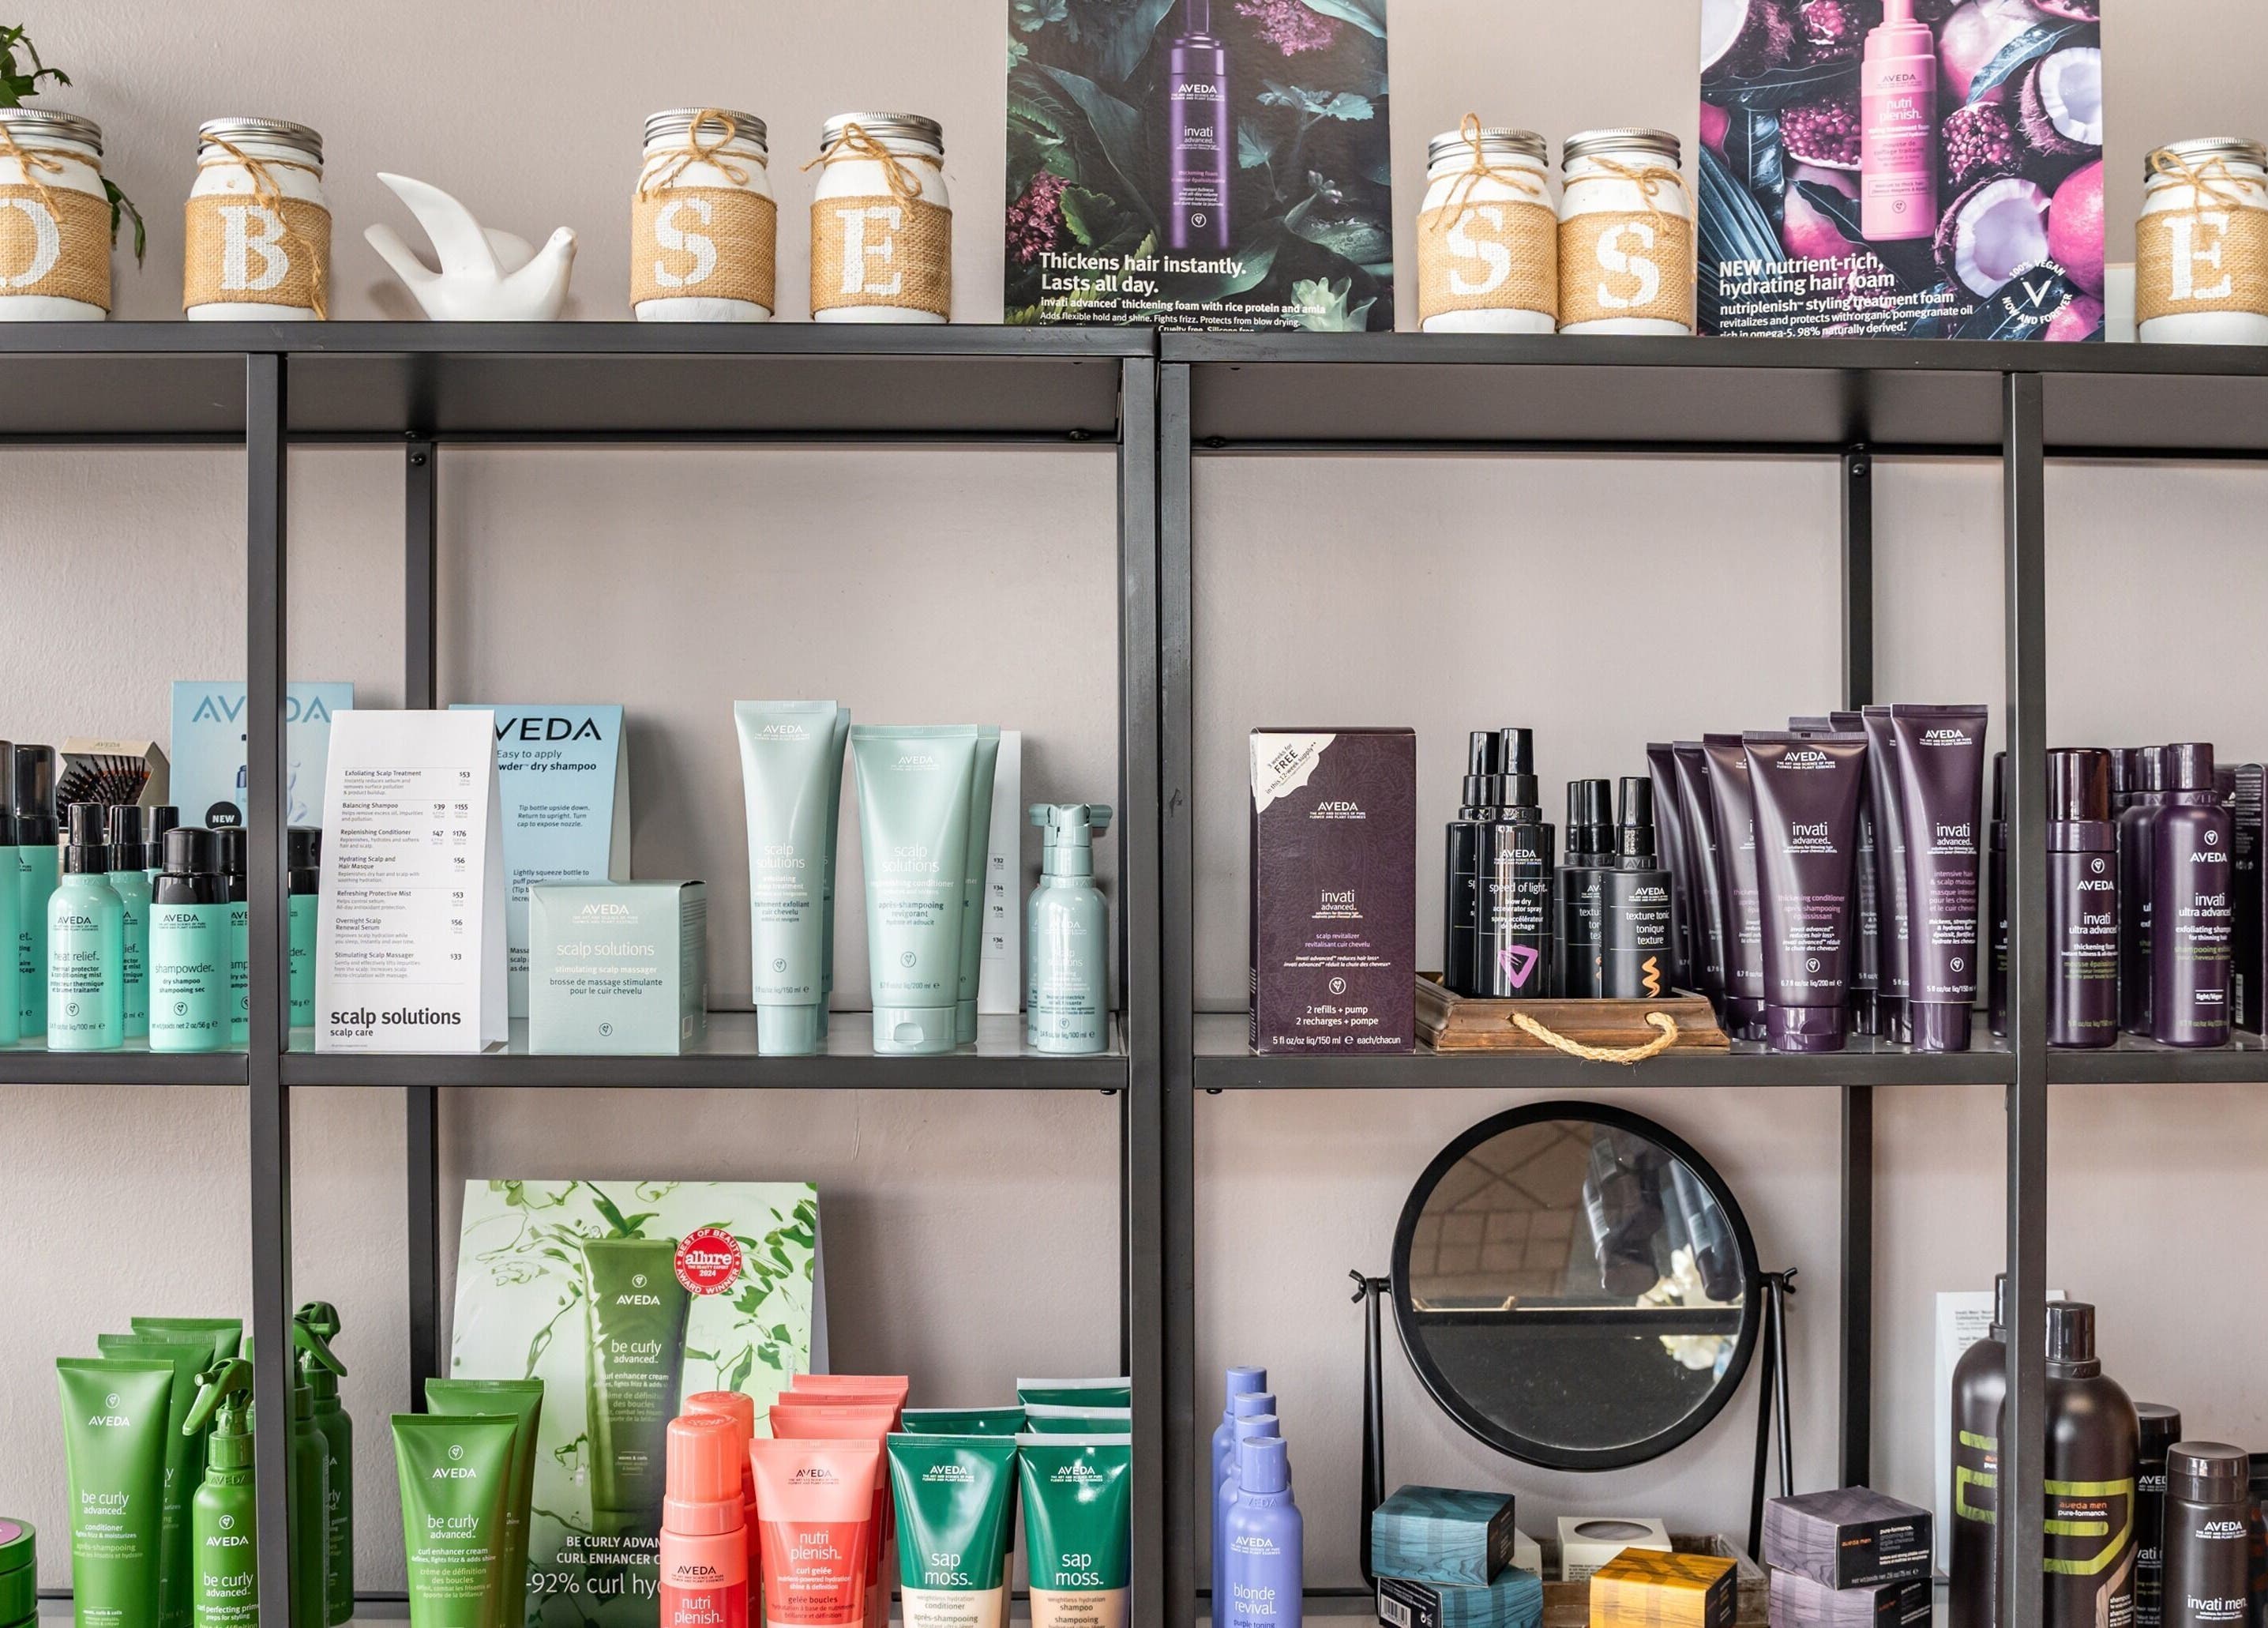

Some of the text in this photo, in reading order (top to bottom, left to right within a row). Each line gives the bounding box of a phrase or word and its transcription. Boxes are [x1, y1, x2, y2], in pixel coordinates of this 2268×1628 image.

[1883, 73, 1916, 83] AVEDA
[1178, 84, 1218, 94] AVEDA
[1887, 98, 1913, 109] nutri
[218, 205, 289, 290] B
[654, 197, 718, 288] S
[835, 205, 903, 295] E
[1447, 206, 1511, 295] S
[2160, 212, 2232, 301] E
[1038, 252, 1246, 278] Thickens hair instantly.
[1597, 221, 1661, 309] S
[1719, 252, 1884, 277] NEW nutrient-rich,
[2009, 259, 2066, 278] 100% VEGAN
[1042, 273, 1159, 297] Lasts all day.
[1719, 273, 1894, 299] hydrating hair foam
[1041, 296, 1300, 314] invati thickening foam with rice protein and
[1806, 293, 1954, 313] styling treatment foam
[2002, 294, 2072, 325] NOW AND FOREVER
[1040, 311, 1061, 320] Adds
[1062, 312, 1091, 321] flexible
[1092, 313, 1110, 321] hold
[1154, 314, 1178, 324] Fights
[1179, 315, 1199, 324] frizz.
[1253, 318, 1272, 326] blow
[1274, 318, 1301, 328] drying.
[1720, 306, 1973, 328] revitalizes and protects organic pomegranate oil
[1797, 322, 1864, 337] 98% naturally
[192, 694, 331, 724] AVDA
[495, 716, 602, 742] VEDA
[764, 724, 803, 734] AVEDA
[1925, 729, 1964, 739] AVEDA
[534, 750, 562, 760] apply
[899, 756, 933, 765] AVEDA
[1274, 749, 1298, 774] FREE
[1784, 752, 1827, 761] AVEDA
[531, 762, 547, 772] dry
[550, 762, 597, 772] shampoo
[1318, 802, 1358, 811] AVEDA
[212, 814, 235, 823] NEW
[1792, 822, 1827, 836] invati
[1936, 822, 1970, 837] invati
[1501, 849, 1536, 858] AVEDA
[2190, 852, 2228, 863] AVEDA
[1489, 882, 1515, 894] speed
[1518, 882, 1528, 893] of
[2077, 881, 2114, 891] AVEDA
[1322, 889, 1354, 903] invati
[2195, 893, 2225, 907] invati
[581, 904, 629, 915] AVEDA
[1626, 910, 1670, 920] texture tonic
[2084, 912, 2111, 925] invati
[1636, 924, 1665, 934] tonique
[556, 941, 655, 959] scalp solutions
[569, 987, 588, 996] pour
[1307, 1005, 1369, 1015] 2 refills pump
[331, 1007, 461, 1028] scalp solutions
[1303, 1017, 1342, 1027] recharges
[1350, 1018, 1379, 1027] pompe
[330, 1028, 353, 1038] scalp
[1279, 1036, 1285, 1044] fl
[1286, 1036, 1305, 1045] oz/oz
[1306, 1036, 1331, 1045] liq/150
[1357, 1036, 1401, 1045] each/chacun
[677, 1234, 695, 1258] BEST
[712, 1229, 741, 1258] BEAUTY
[685, 1250, 732, 1265] allure
[677, 1268, 740, 1294] AWARD WINNER
[616, 1295, 661, 1305] AVEDA
[611, 1340, 662, 1357] be curly
[88, 1416, 130, 1427] AVEDA
[432, 1468, 477, 1479] AVEDA
[796, 1469, 832, 1478] AVEDA
[929, 1465, 967, 1475] AVEDA
[1057, 1466, 1095, 1475] AVEDA
[81, 1490, 130, 1508] be curly
[427, 1513, 479, 1531] be curly
[2204, 1521, 2243, 1532] AVEDA
[206, 1536, 249, 1547] AVEDA
[566, 1536, 660, 1548] BE CURLY ADVAN
[800, 1531, 828, 1544] nutri
[1236, 1536, 1273, 1547] AVEDA
[557, 1553, 586, 1564] CURL
[589, 1553, 651, 1565] ENHANCER
[931, 1552, 960, 1568] sap
[1062, 1553, 1091, 1568] sap
[677, 1566, 716, 1574] AVEDA
[204, 1571, 253, 1588] be curly
[525, 1573, 580, 1594] -92%
[587, 1573, 625, 1595] curl
[1234, 1582, 1275, 1600] blonde
[682, 1596, 711, 1609] nutri
[788, 1596, 808, 1604] gelée
[2187, 1594, 2222, 1611] invati
[1060, 1604, 1093, 1612] shampoo
